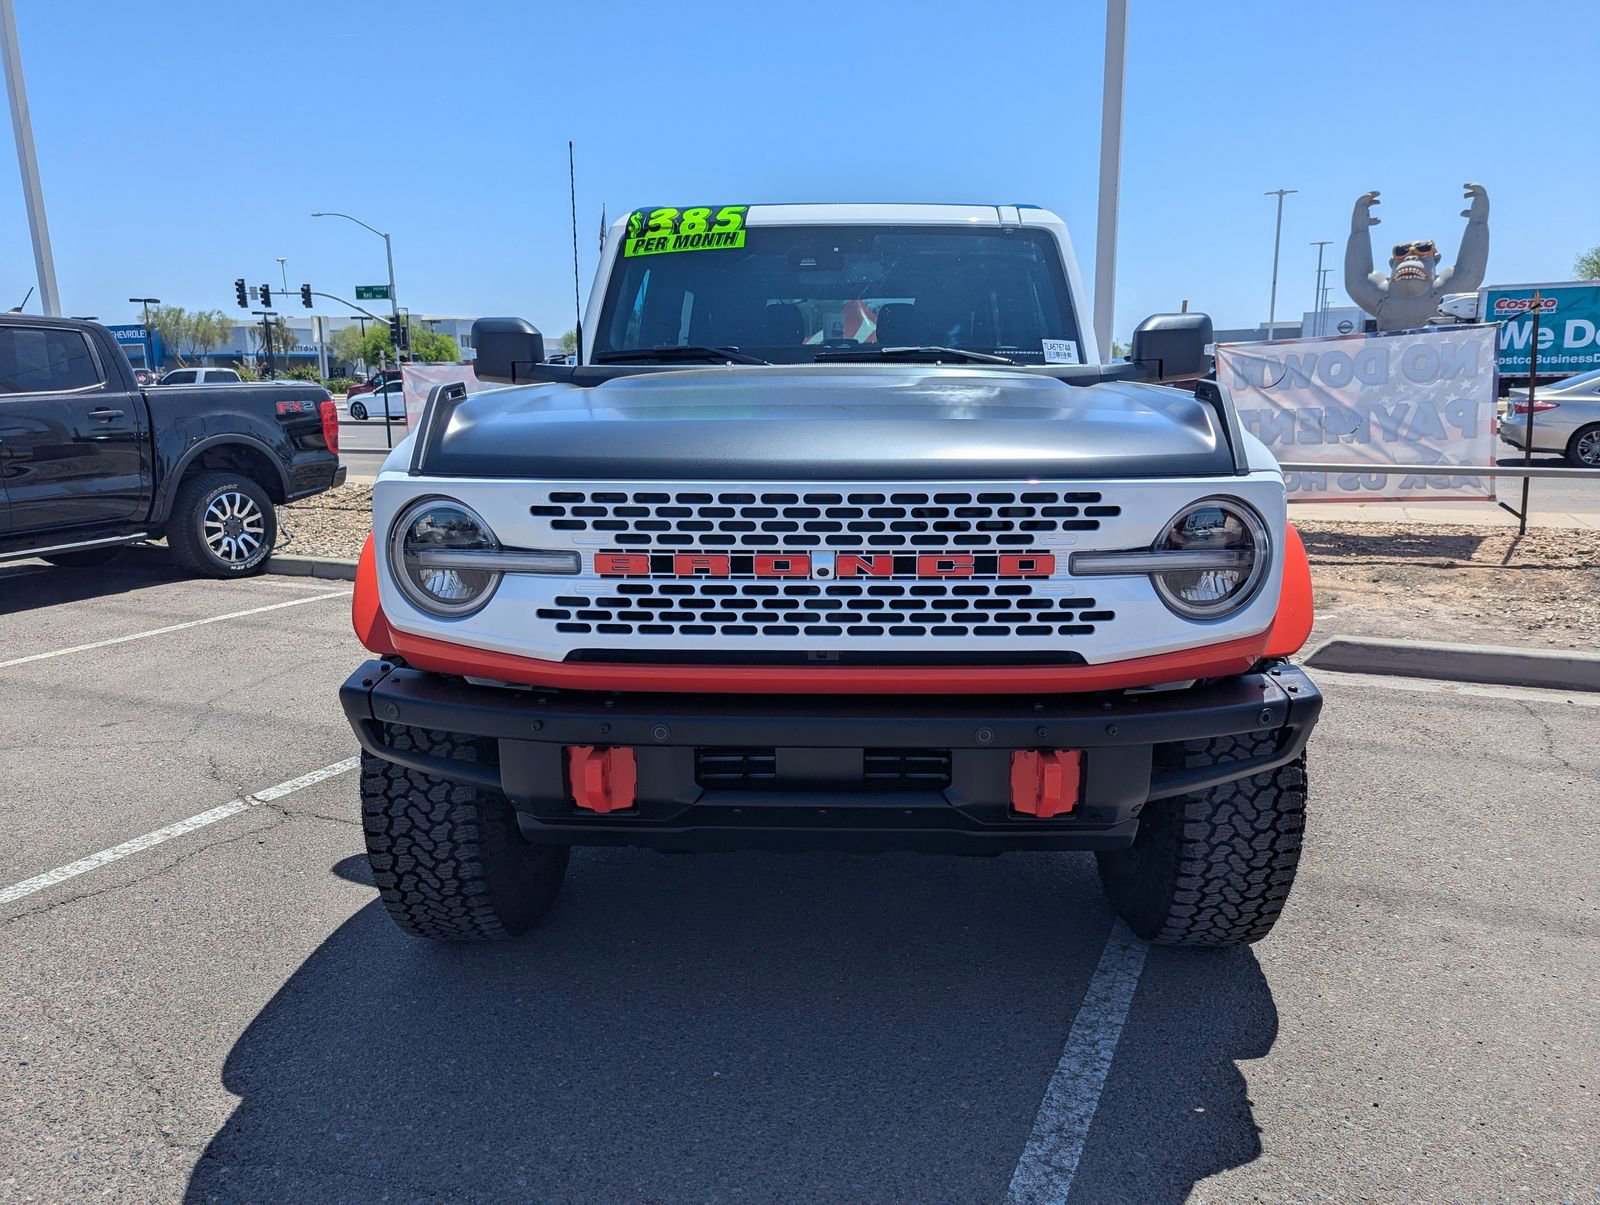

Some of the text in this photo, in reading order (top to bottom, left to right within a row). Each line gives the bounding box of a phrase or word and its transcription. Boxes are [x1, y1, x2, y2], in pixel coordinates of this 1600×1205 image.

[628, 206, 747, 238] $385
[632, 231, 740, 254] PER MONTH
[1494, 298, 1558, 310] COSTO
[1500, 319, 1600, 350] We D
[276, 401, 316, 414] FX2
[594, 553, 1056, 576] BRONCO
